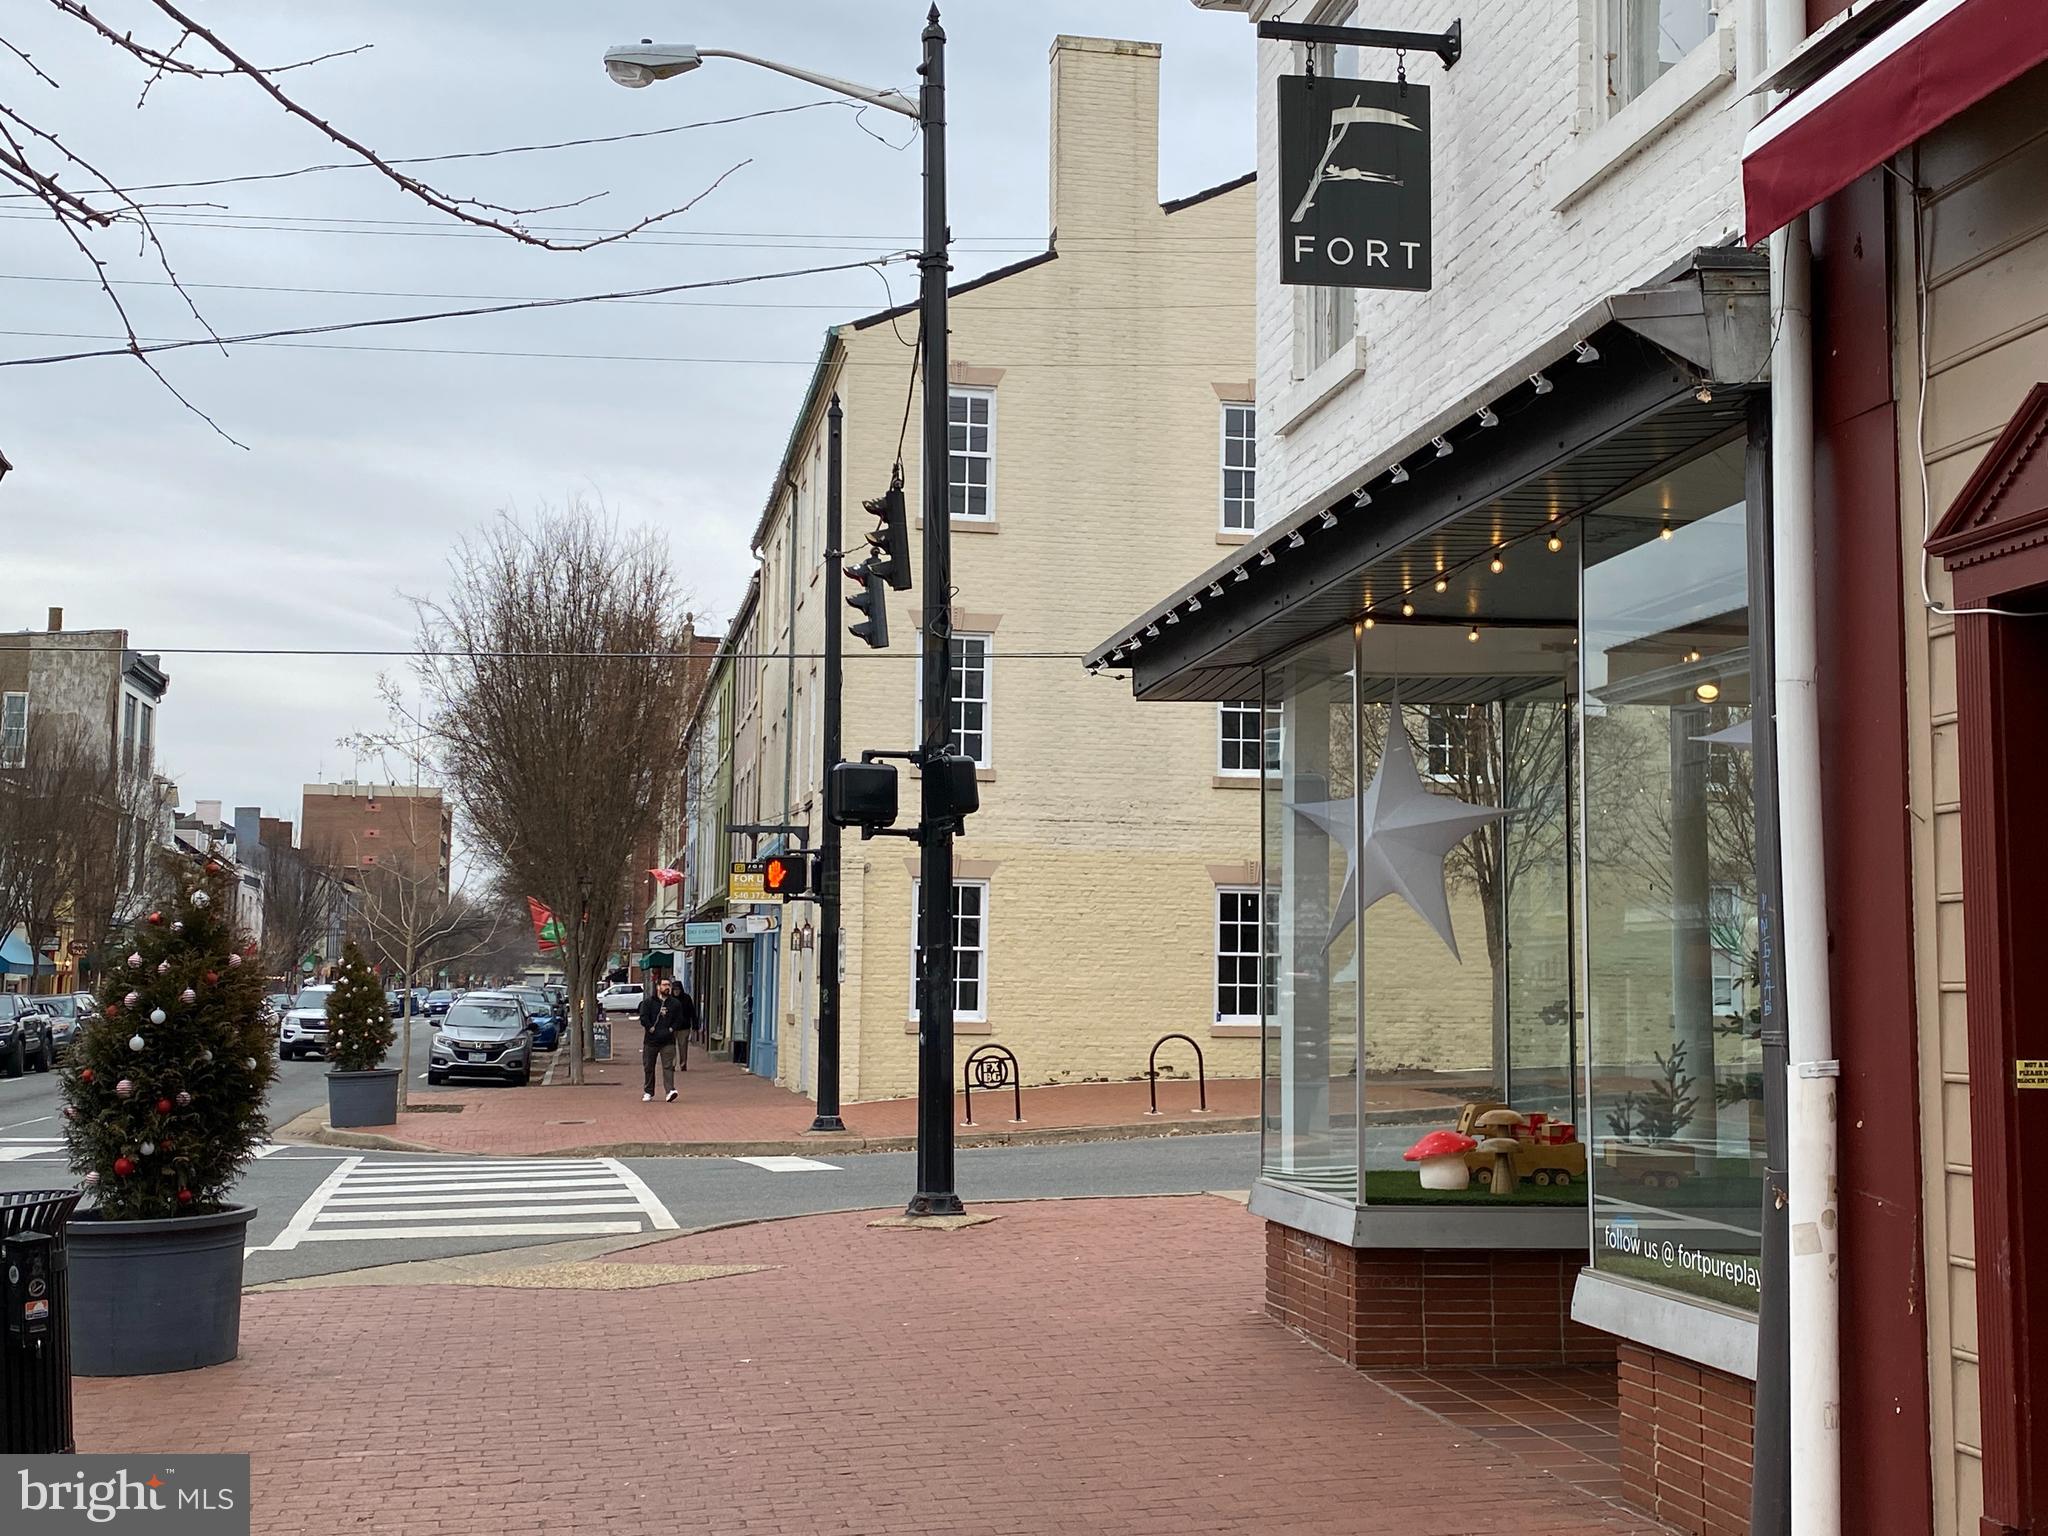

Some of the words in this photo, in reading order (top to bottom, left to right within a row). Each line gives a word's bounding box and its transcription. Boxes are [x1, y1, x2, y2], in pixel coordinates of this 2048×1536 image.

[1294, 235, 1421, 270] FORT
[734, 875, 754, 883] FOR
[1605, 1225, 1641, 1255] follow
[1644, 1241, 1658, 1260] us
[1661, 1240, 1675, 1268] @
[1677, 1244, 1761, 1292] fortpureplay
